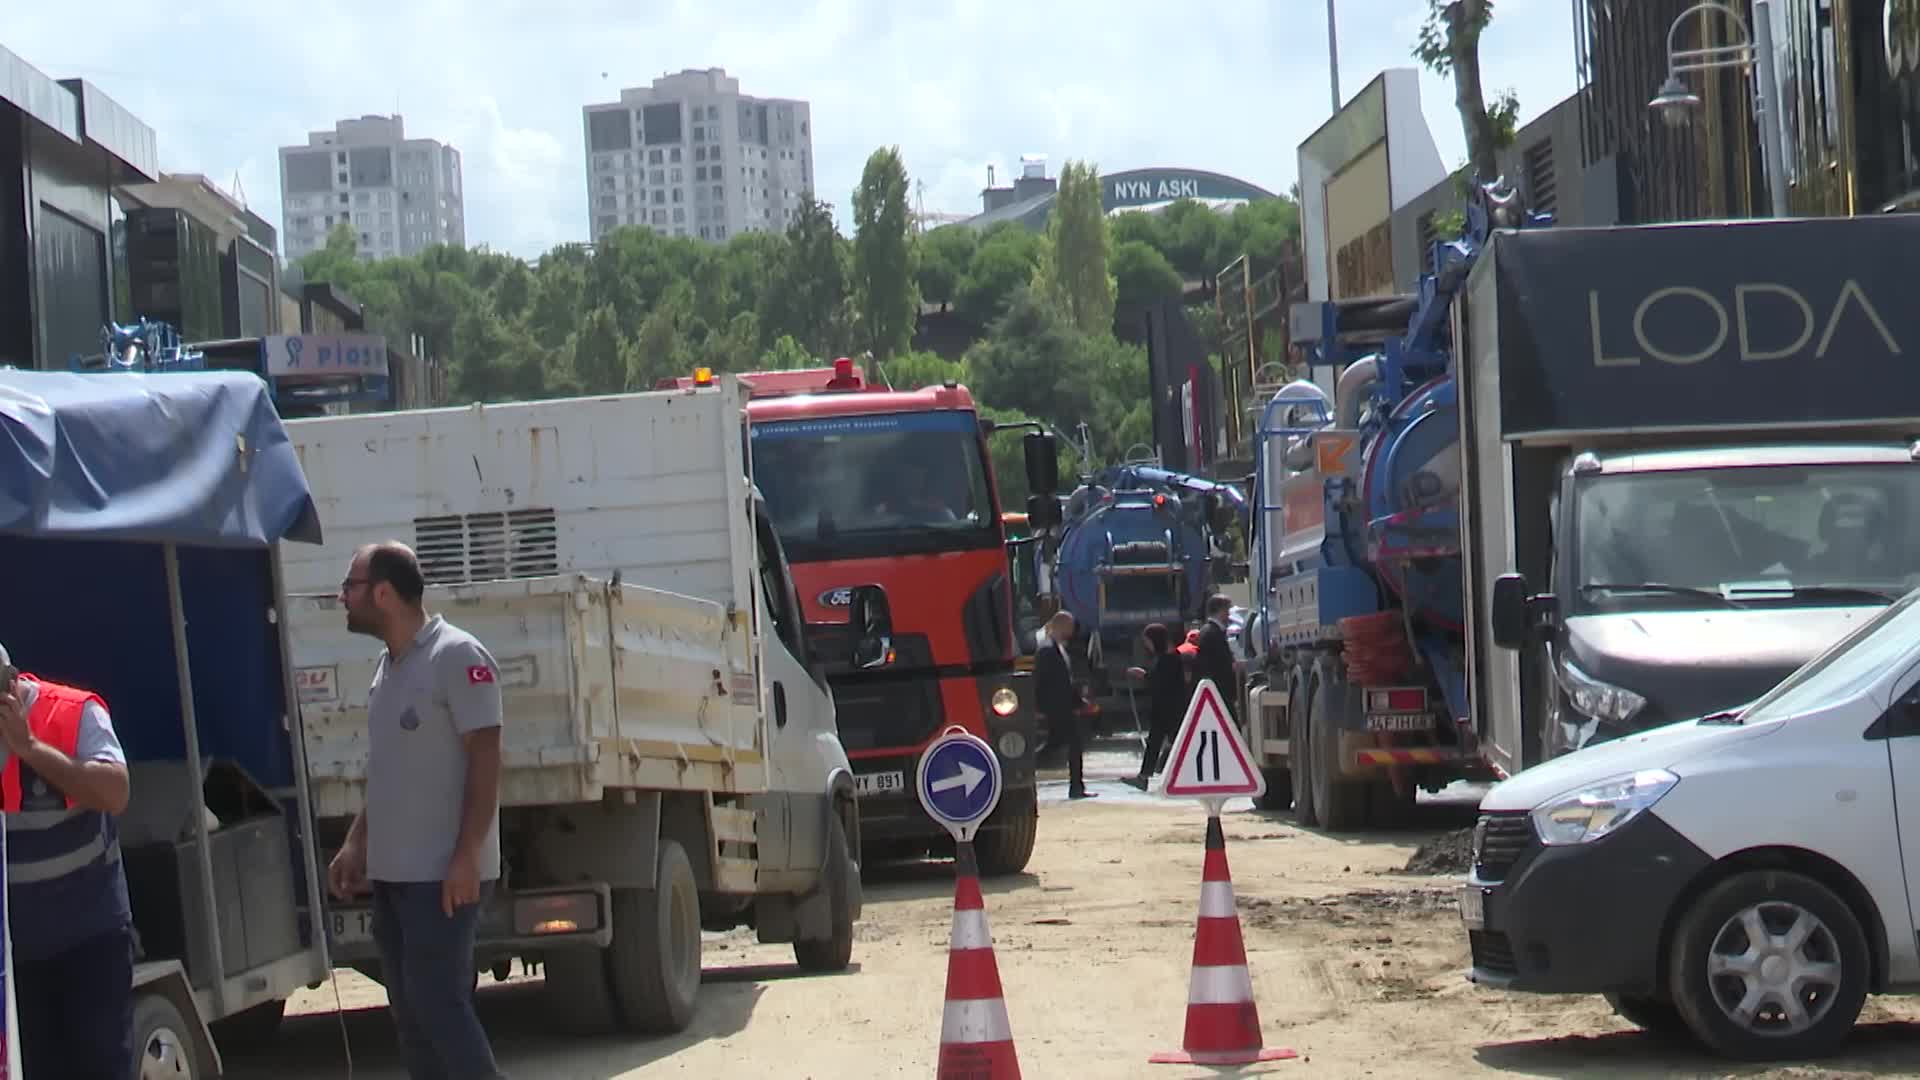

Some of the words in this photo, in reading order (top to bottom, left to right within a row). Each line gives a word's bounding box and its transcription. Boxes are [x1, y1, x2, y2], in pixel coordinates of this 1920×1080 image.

[1115, 181, 1150, 200] NYN
[1589, 279, 1901, 366] LODA
[877, 773, 900, 789] 891
